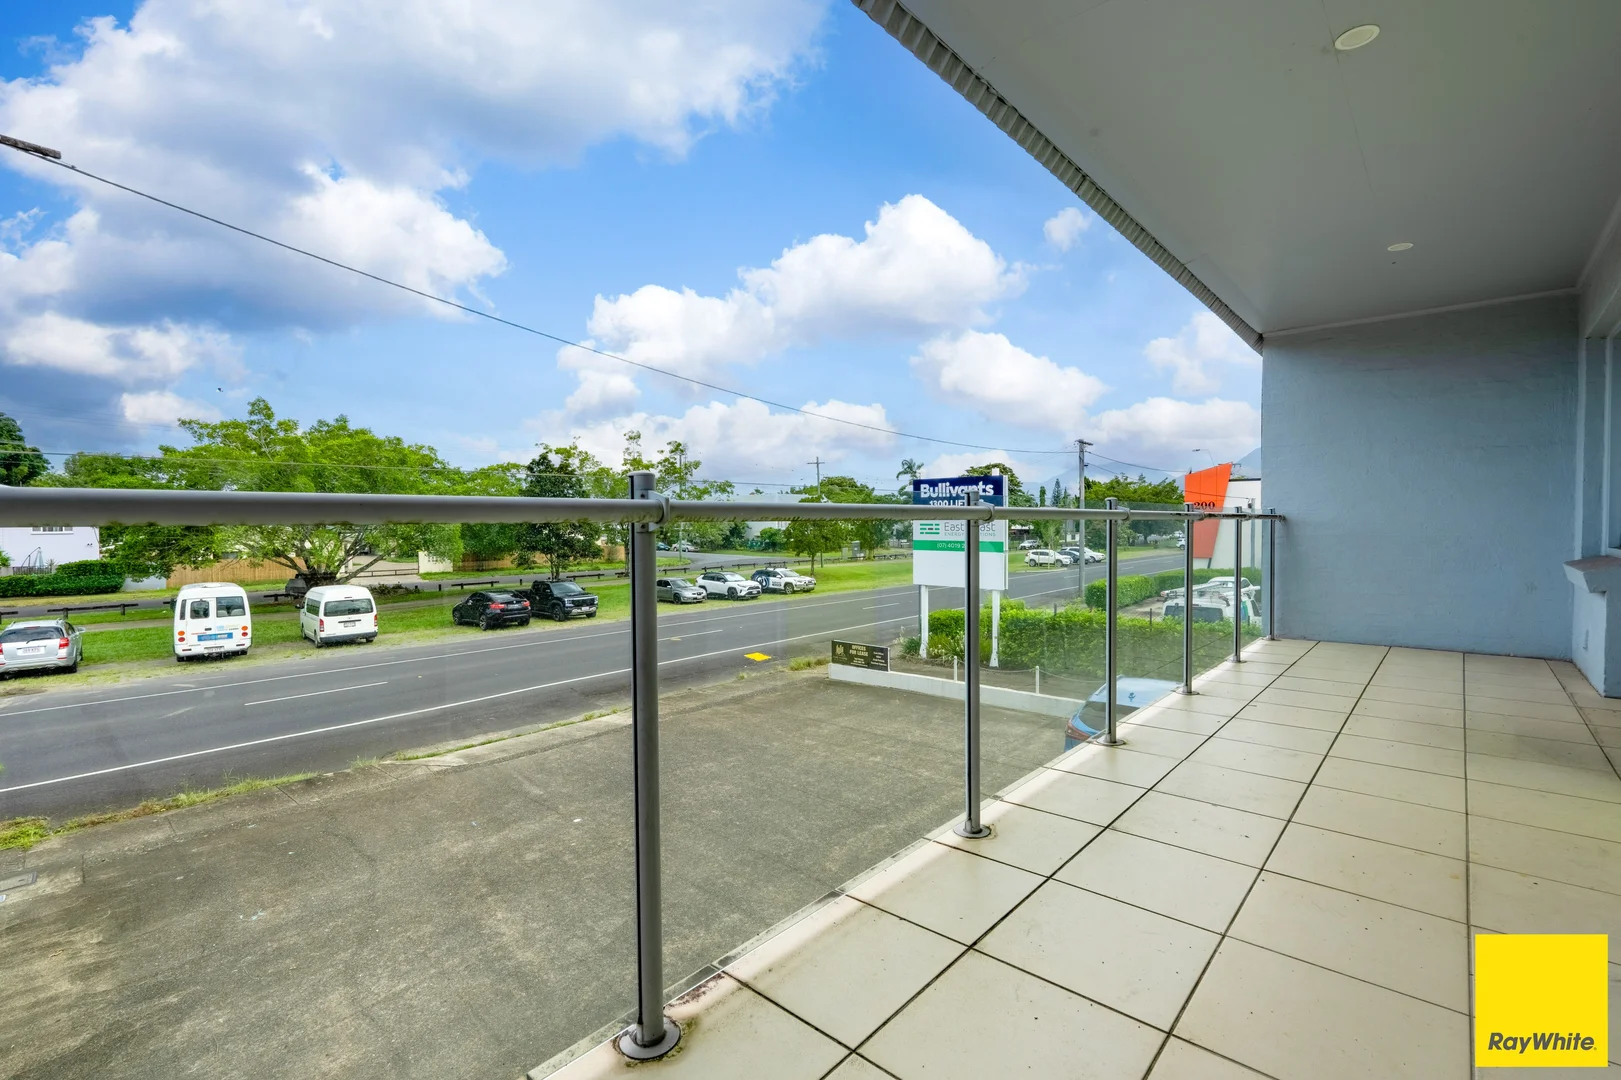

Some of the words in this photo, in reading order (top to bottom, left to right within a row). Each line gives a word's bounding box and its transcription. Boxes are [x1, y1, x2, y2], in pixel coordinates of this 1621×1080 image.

[920, 481, 994, 498] Bullivants
[1194, 501, 1215, 510] 200
[944, 522, 965, 532] East
